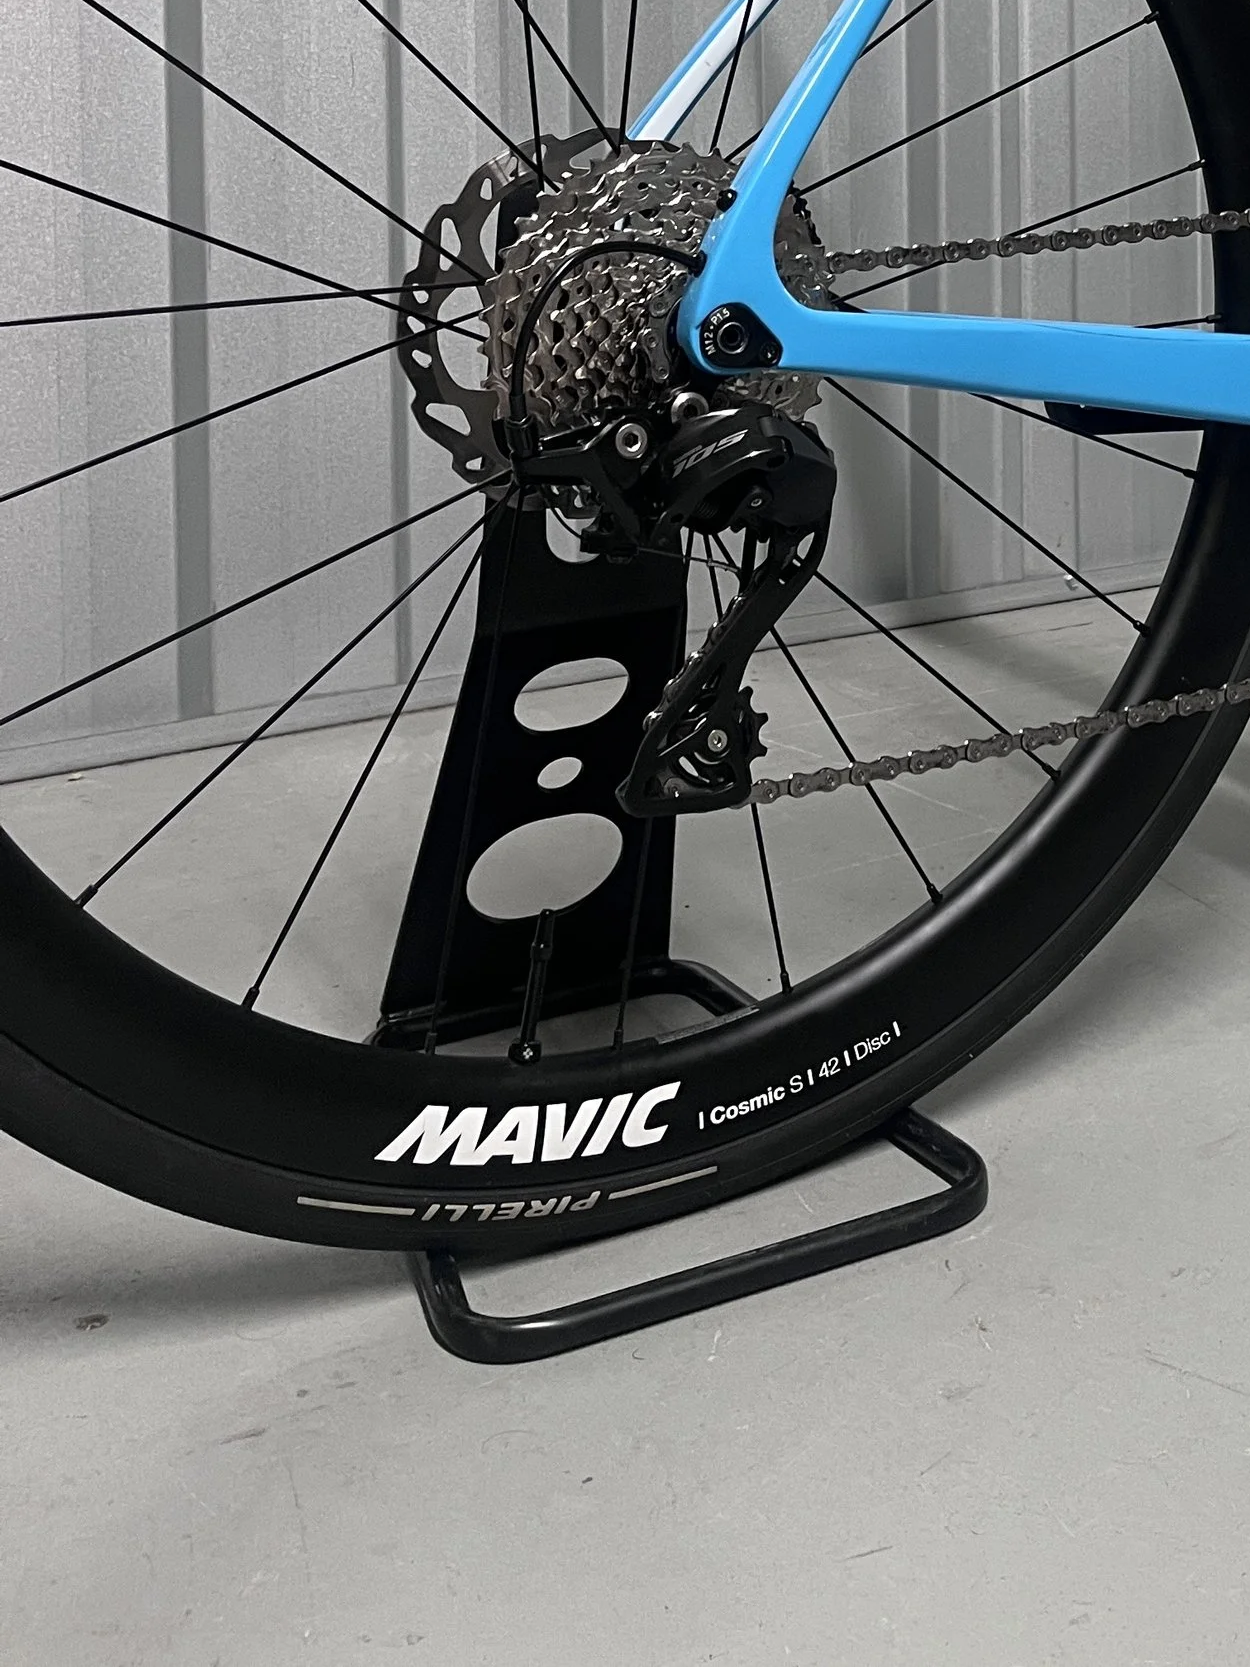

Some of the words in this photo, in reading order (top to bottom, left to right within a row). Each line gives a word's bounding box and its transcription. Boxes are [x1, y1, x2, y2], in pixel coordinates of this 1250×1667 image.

[671, 428, 749, 479] 105
[709, 1086, 786, 1125] Cosmic
[789, 1074, 804, 1094] S
[818, 1056, 841, 1078] 42
[853, 1031, 891, 1061] Disc
[373, 1080, 681, 1166] MAVIC
[421, 1190, 602, 1222] PIRELLI
